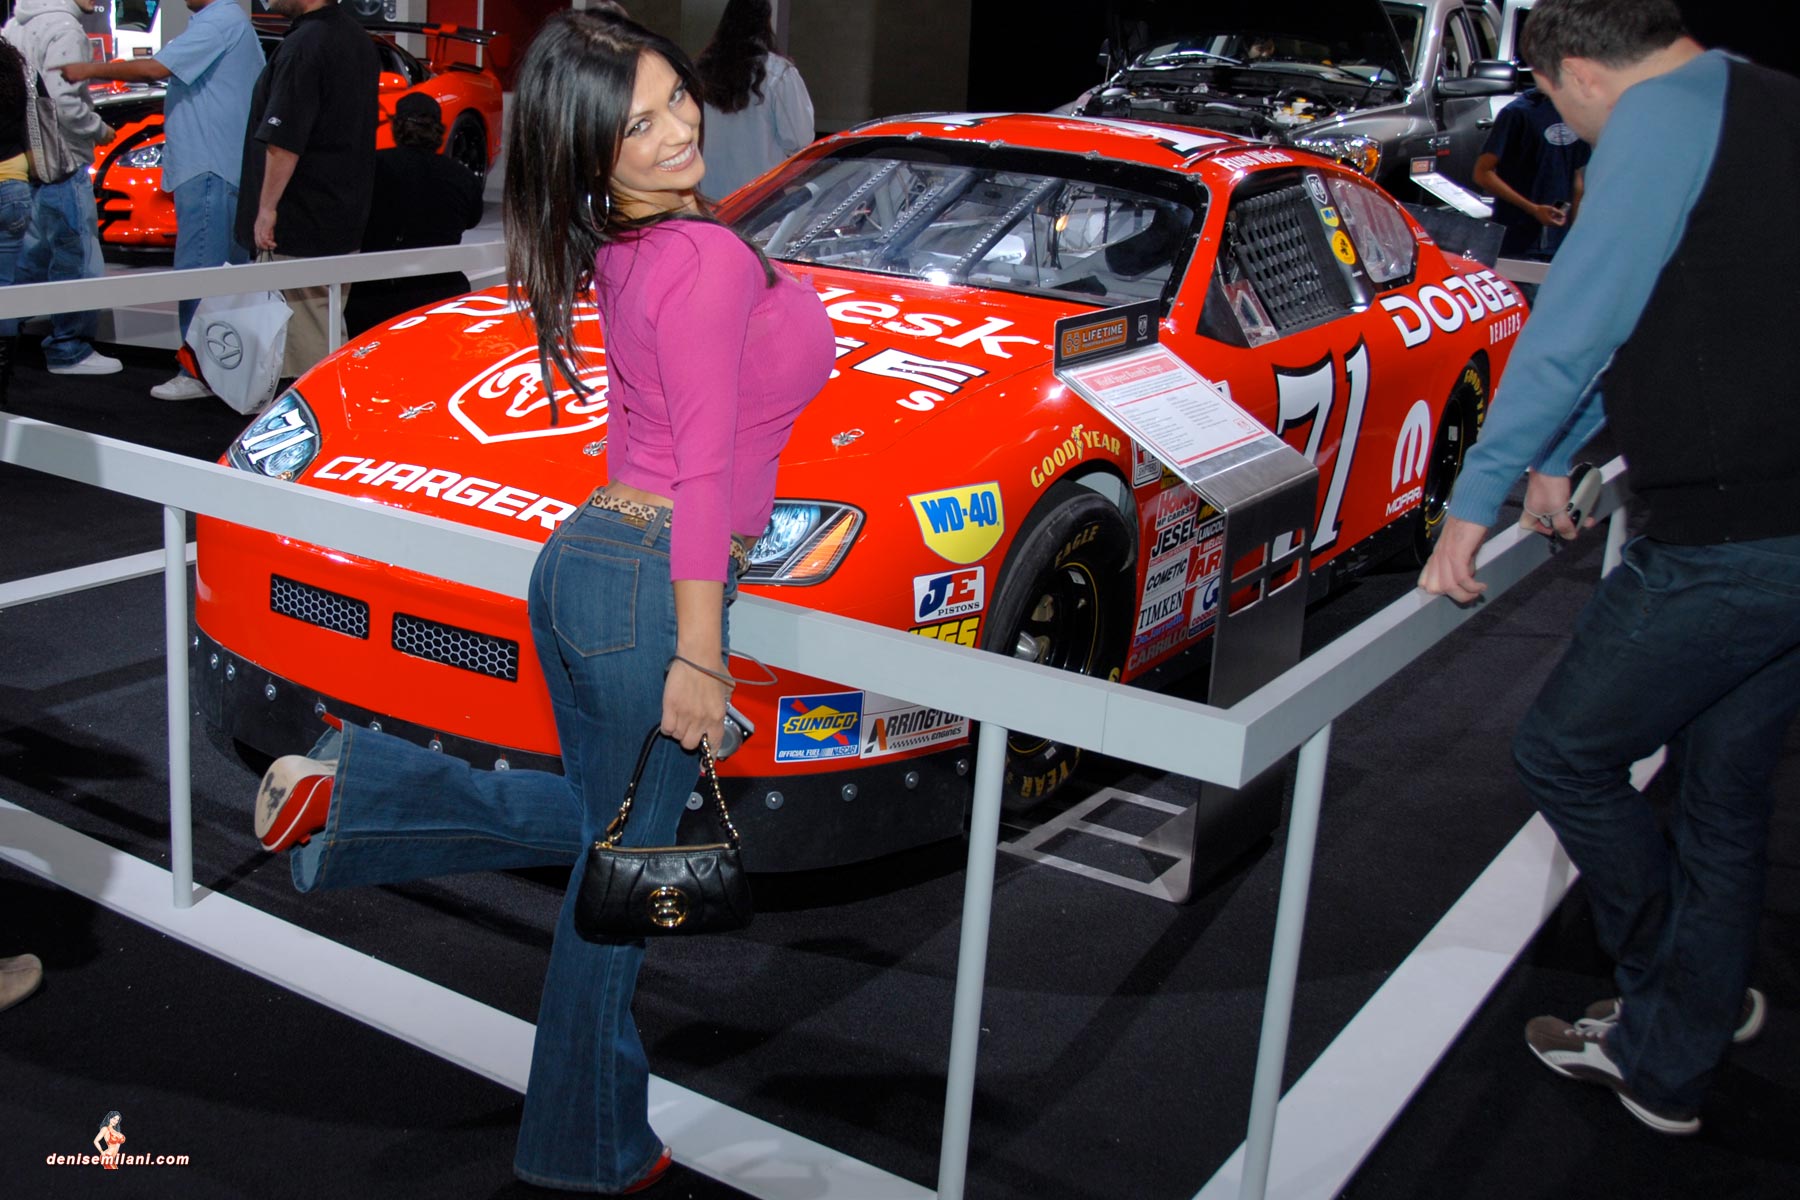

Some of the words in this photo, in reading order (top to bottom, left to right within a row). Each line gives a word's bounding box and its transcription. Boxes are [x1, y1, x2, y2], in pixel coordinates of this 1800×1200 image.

[1379, 270, 1518, 349] DODGE
[1489, 312, 1521, 345] DEALERS
[1082, 323, 1124, 343] LIFETIME
[240, 408, 316, 466] 71
[1272, 333, 1370, 562] 71
[313, 456, 577, 531] CHARGER
[920, 491, 998, 534] WD-40
[1385, 486, 1422, 517] MOPAR
[1152, 517, 1196, 558] JESEL
[919, 570, 978, 618] JE
[1146, 557, 1188, 592] COMETIC
[938, 602, 980, 616] PISTONS
[1138, 589, 1185, 630] TIMKEN
[1128, 625, 1188, 671] CARRILLO
[786, 714, 855, 732] SUNOCO
[779, 749, 804, 758] OFFICIAL
[806, 748, 820, 757] FUEL
[833, 745, 857, 756] NASCAR
